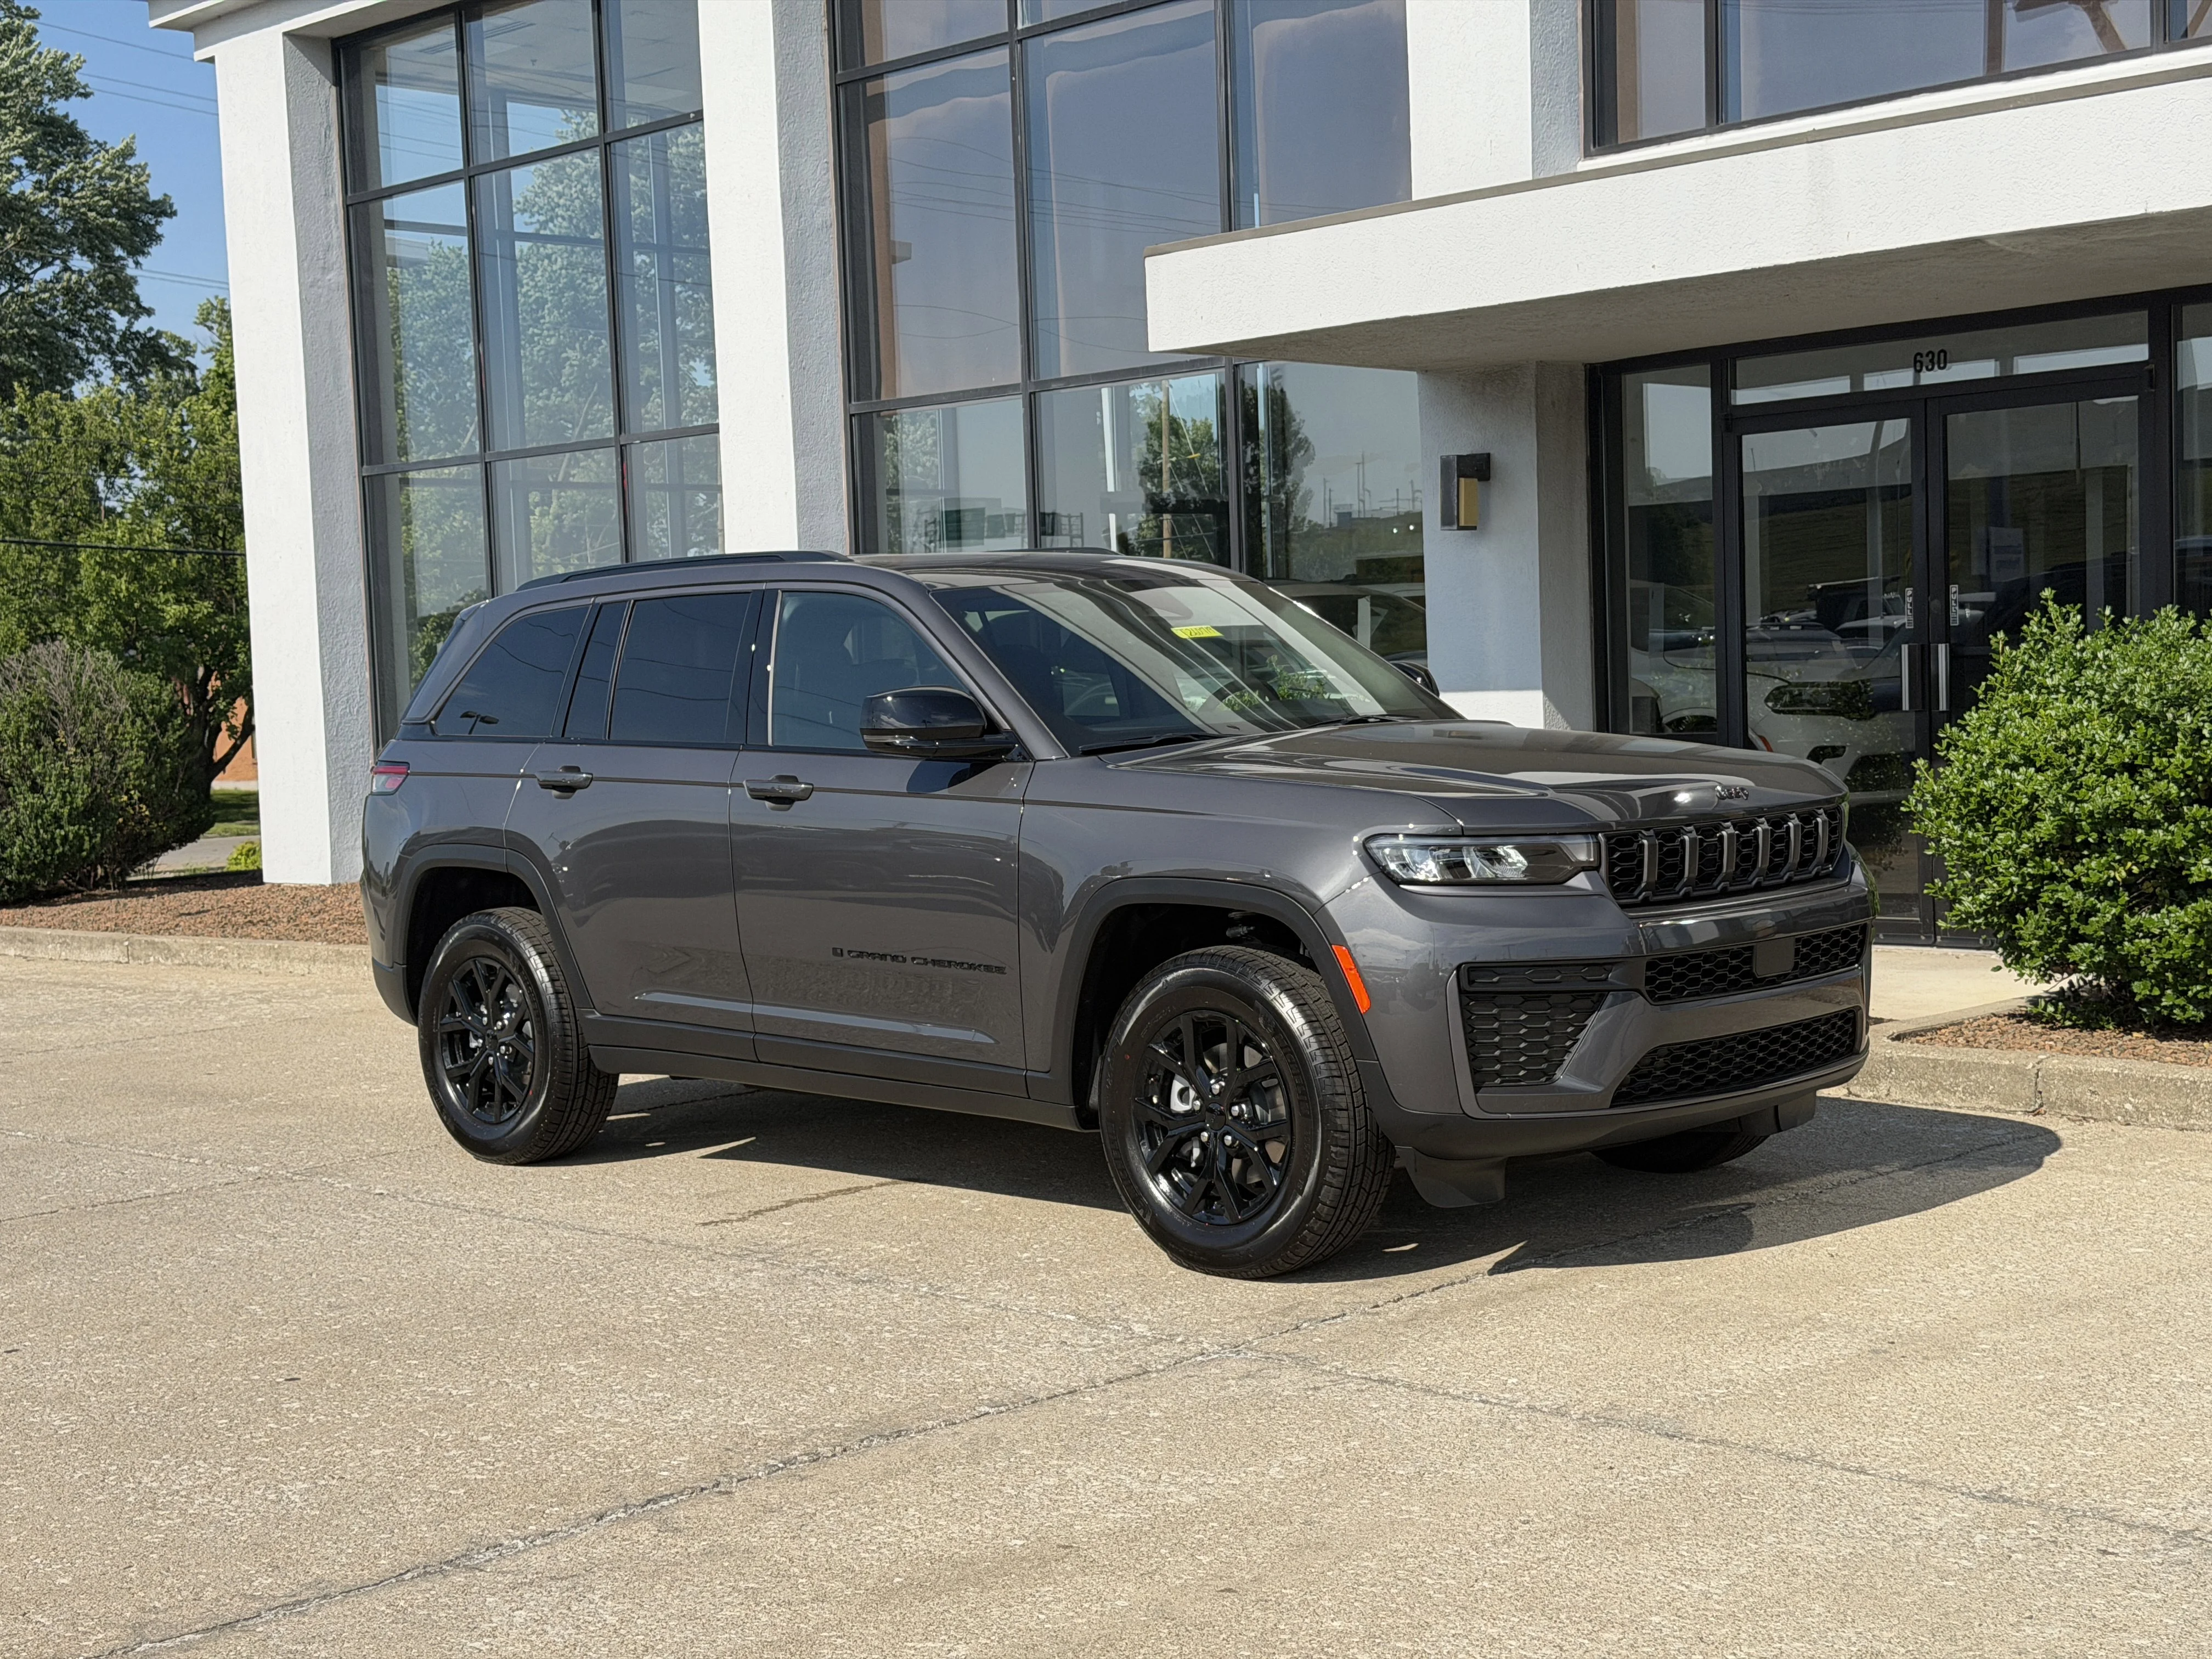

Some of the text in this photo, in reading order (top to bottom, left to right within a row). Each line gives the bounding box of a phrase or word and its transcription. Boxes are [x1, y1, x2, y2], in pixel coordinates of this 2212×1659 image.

[1913, 349, 1948, 373] 630
[847, 950, 1007, 975] GRAND CHEROKEE
